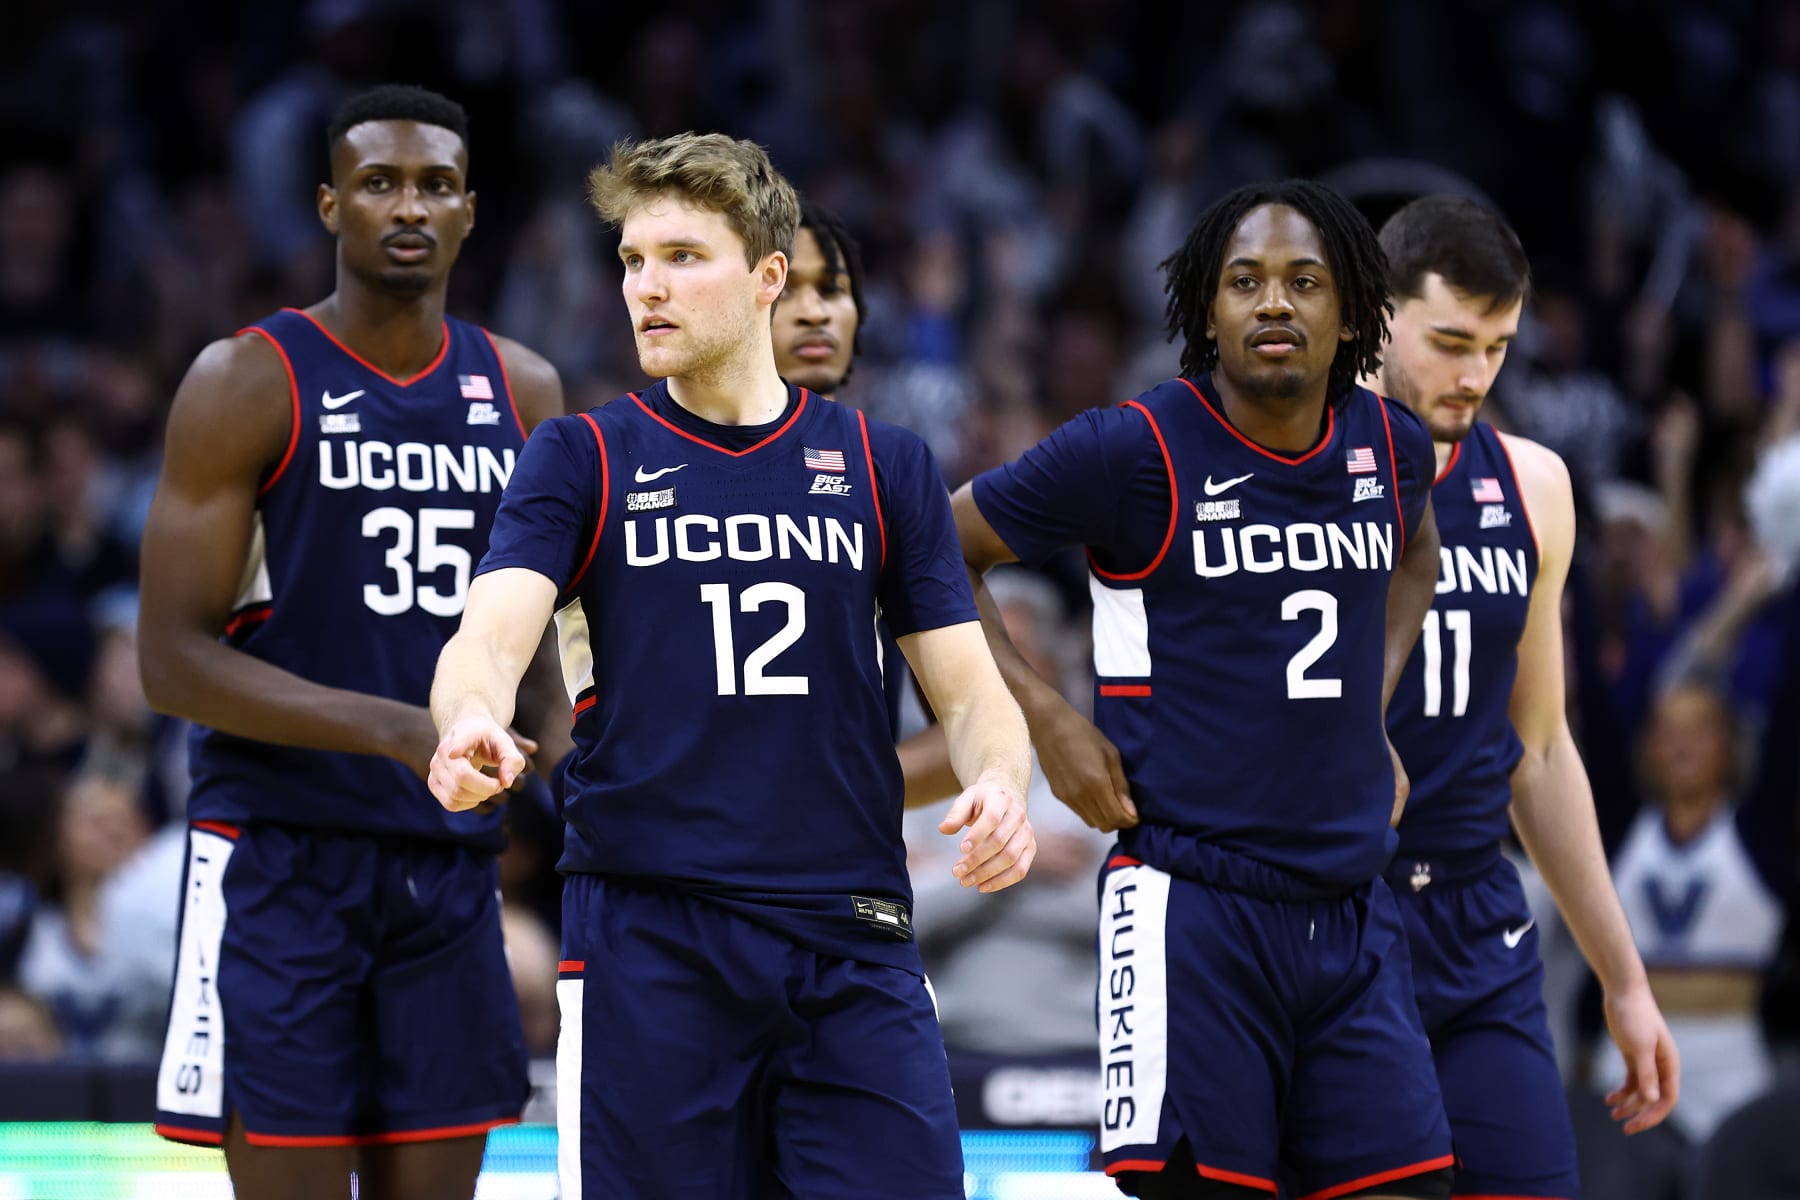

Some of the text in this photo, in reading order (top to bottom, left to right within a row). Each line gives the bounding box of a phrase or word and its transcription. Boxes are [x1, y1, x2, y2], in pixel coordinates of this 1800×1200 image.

[318, 440, 515, 493] UCONN
[810, 482, 852, 493] EAST
[814, 474, 845, 484] BIG
[627, 498, 674, 511] CHANGE
[362, 507, 475, 617] 35
[624, 514, 863, 571] UCONN
[1192, 523, 1393, 578] UCONN
[700, 581, 809, 696] 12
[1281, 589, 1343, 700] 2
[1422, 609, 1472, 717] 11
[1104, 884, 1137, 1131] HUSKIES
